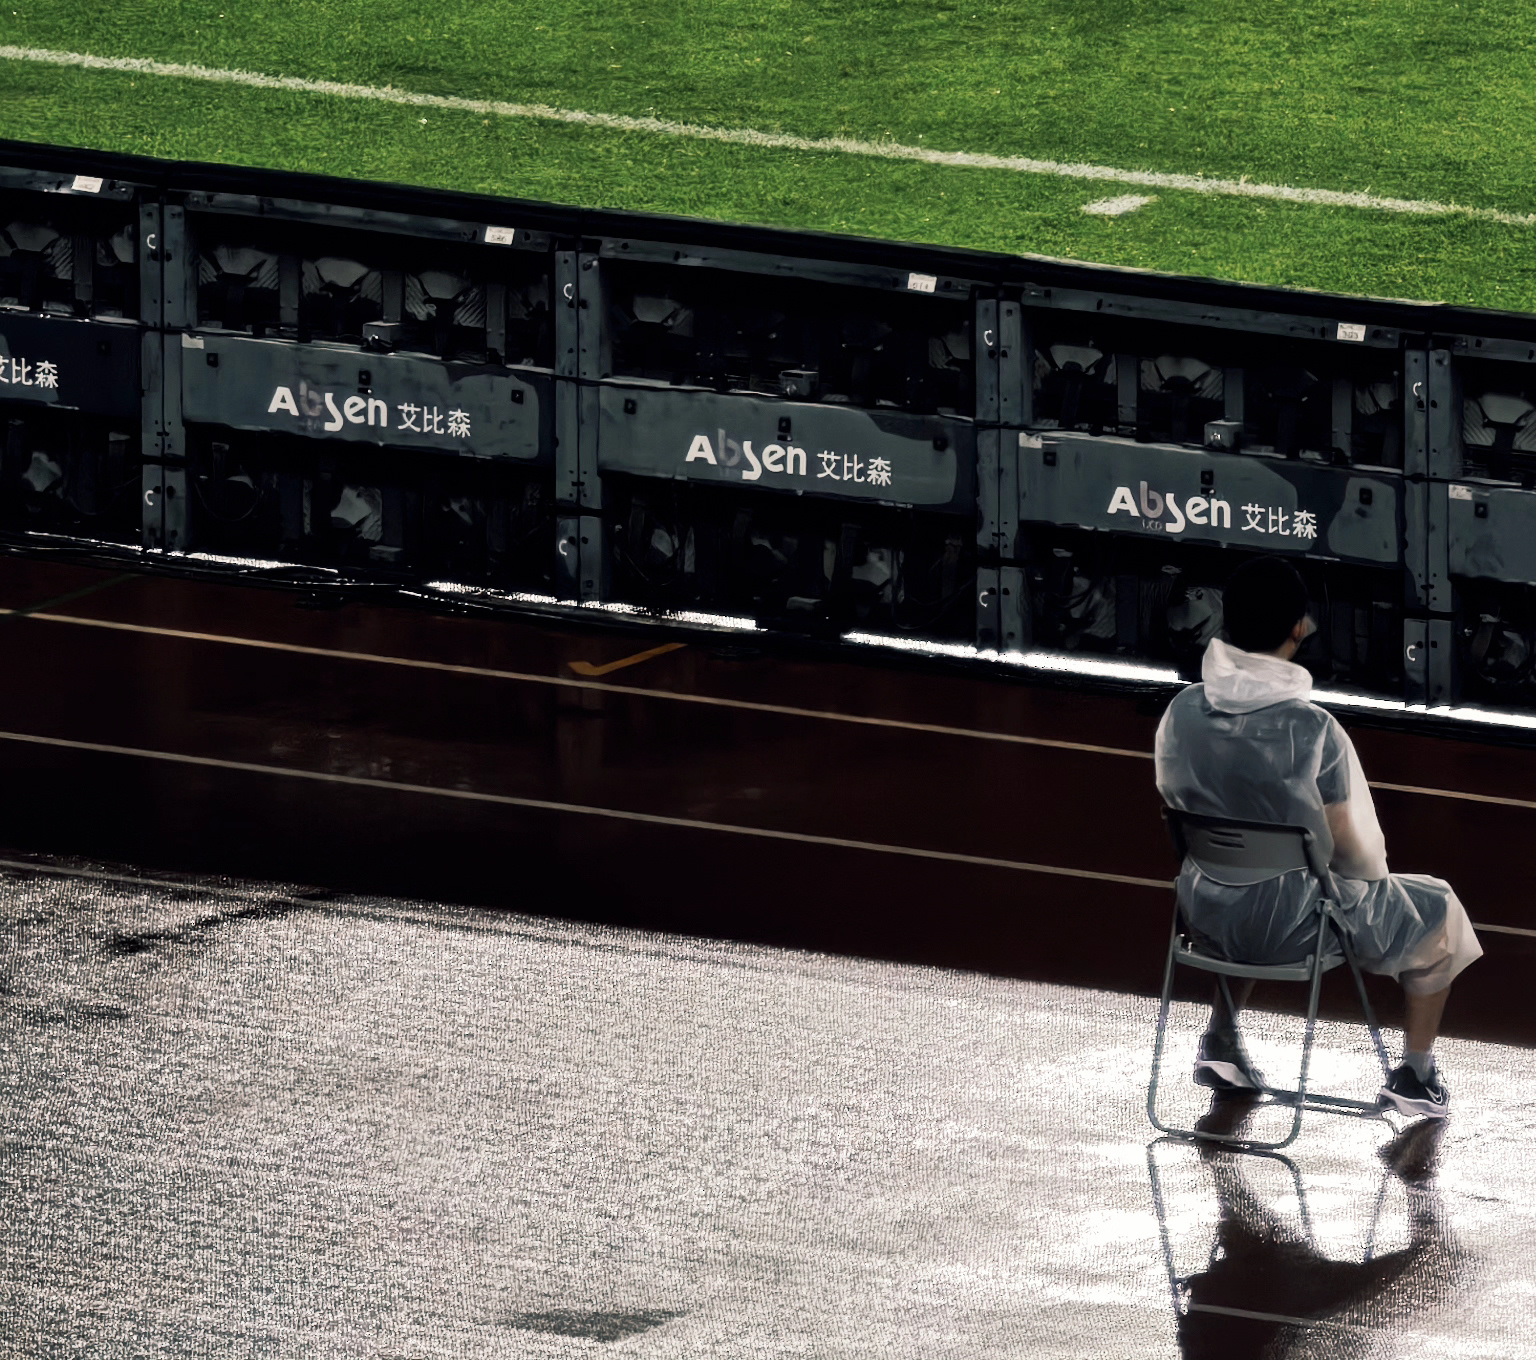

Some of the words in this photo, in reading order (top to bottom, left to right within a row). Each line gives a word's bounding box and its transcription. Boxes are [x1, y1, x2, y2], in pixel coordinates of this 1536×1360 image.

[397, 402, 471, 438] 艾比森
[816, 450, 892, 487] 艾比森
[1107, 480, 1232, 533] Absen
[1241, 502, 1318, 539] 艾比森
